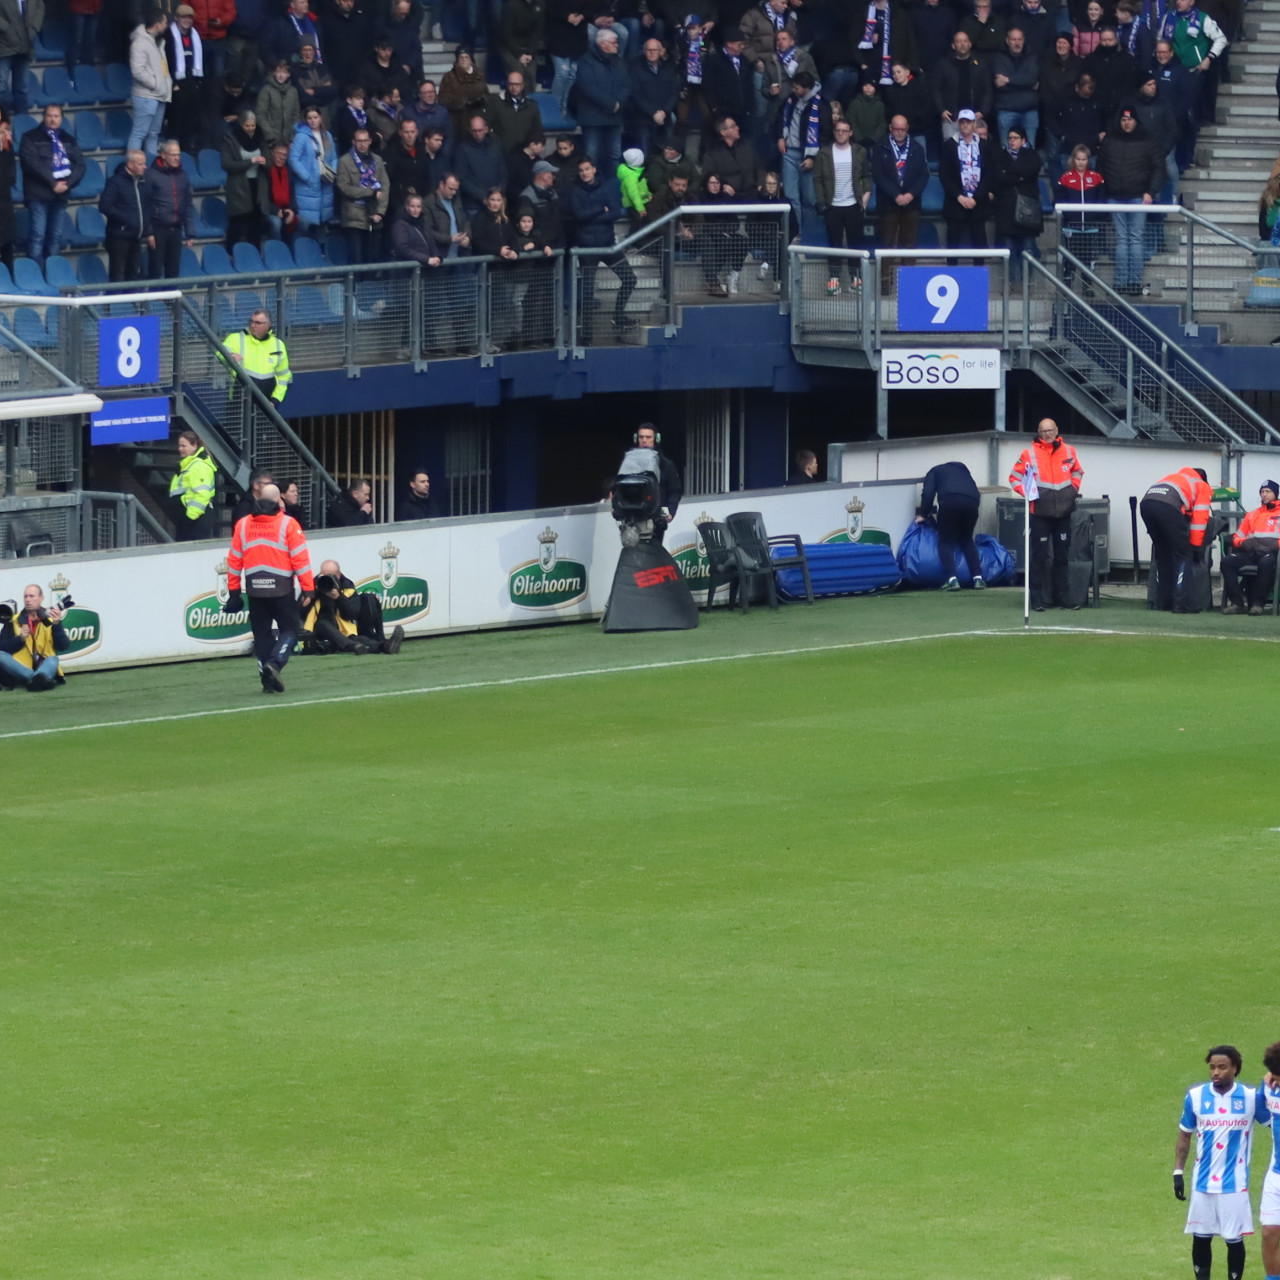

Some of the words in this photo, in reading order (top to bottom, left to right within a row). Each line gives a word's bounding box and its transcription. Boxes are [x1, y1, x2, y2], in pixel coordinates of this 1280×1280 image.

[926, 274, 959, 324] 9
[118, 326, 141, 378] 8
[962, 360, 976, 369] for
[513, 574, 581, 596] Oliehoorn
[633, 565, 678, 588] ESPN
[1205, 1115, 1248, 1127] Ausnutria
